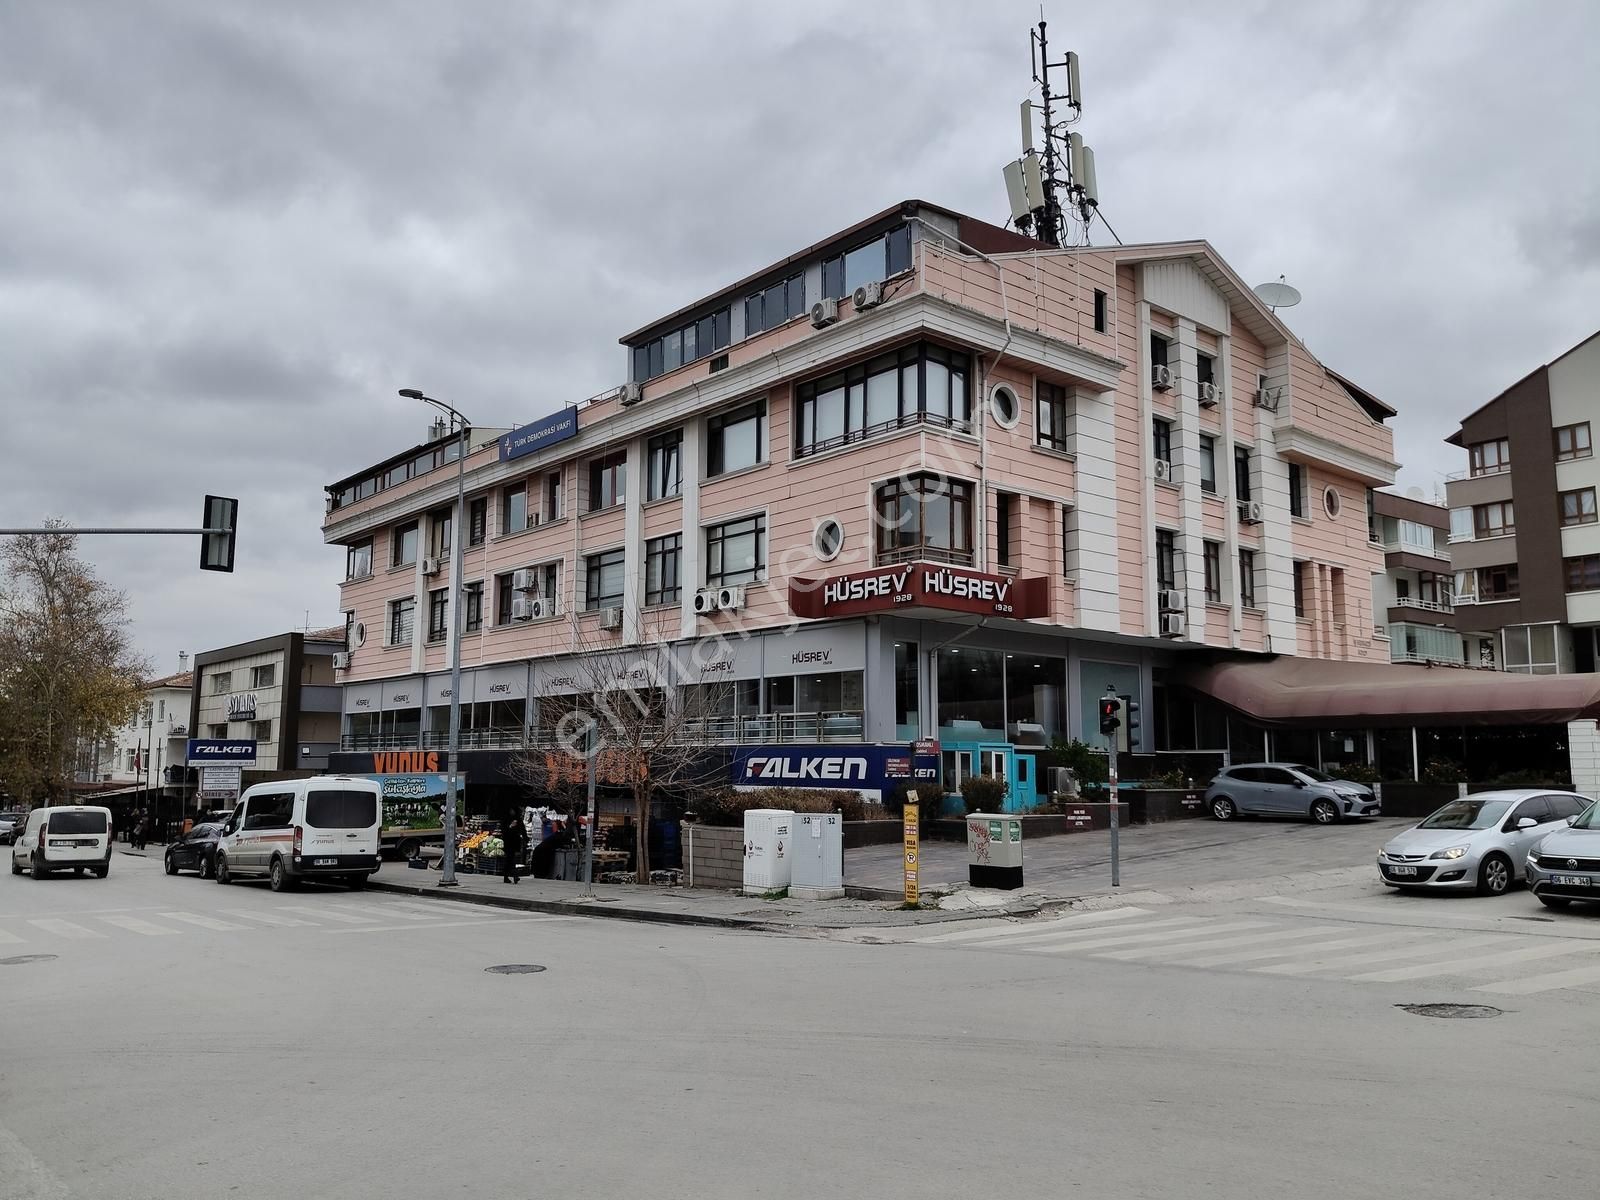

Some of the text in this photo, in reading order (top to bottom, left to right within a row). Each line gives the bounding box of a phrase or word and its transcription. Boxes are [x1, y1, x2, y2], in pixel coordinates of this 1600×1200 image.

[514, 419, 571, 448] TÜRK DEMOKRASİ VAKFI
[824, 572, 907, 605] HÜSREV
[925, 569, 1008, 601] HÜSREV
[893, 594, 912, 603] 1928
[995, 603, 1013, 612] 1928
[791, 650, 829, 664] HÜSREV
[489, 683, 511, 694] HÜSREV
[195, 746, 253, 754] FALKEN
[746, 757, 867, 780] FALKEN
